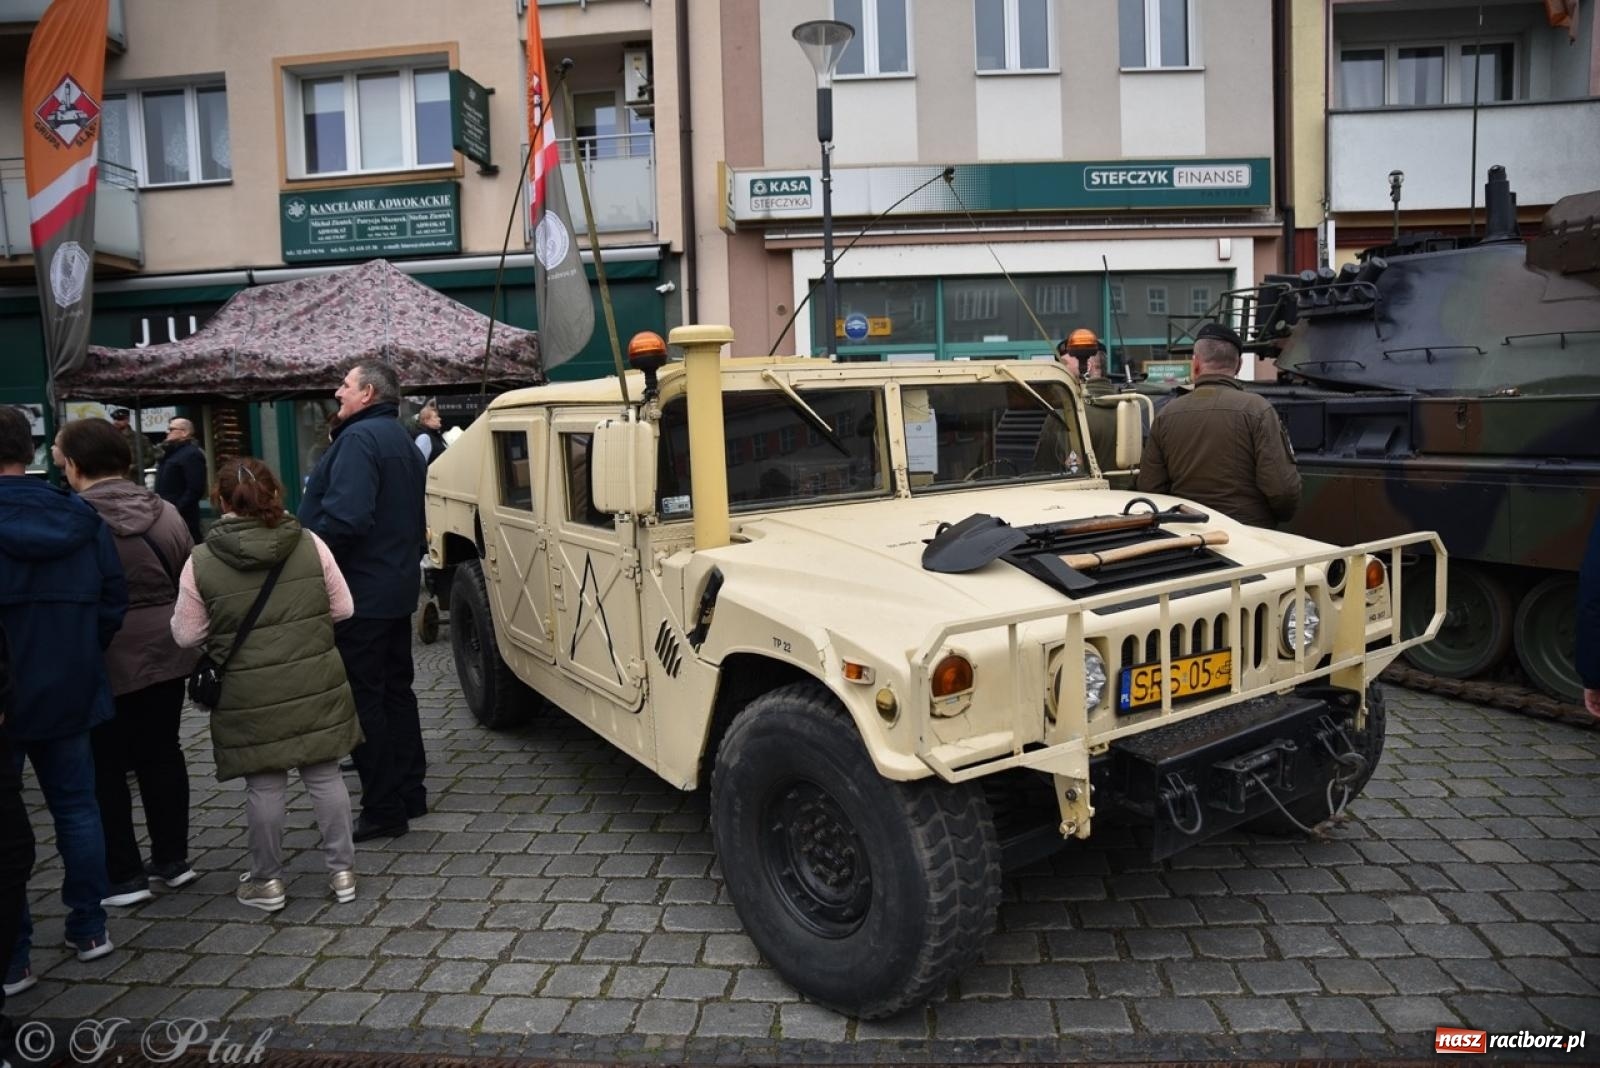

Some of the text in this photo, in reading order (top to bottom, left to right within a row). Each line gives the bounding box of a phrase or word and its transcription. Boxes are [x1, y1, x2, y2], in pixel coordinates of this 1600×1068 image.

[1091, 169, 1244, 186] STEFCZYK FINANSE
[769, 180, 808, 193] KASA
[310, 194, 452, 215] KANCELARIE ADWOKACKIE
[753, 197, 810, 210] STEFCZYKA
[771, 636, 792, 653] TP 22
[1120, 657, 1212, 704] PL SRS 05
